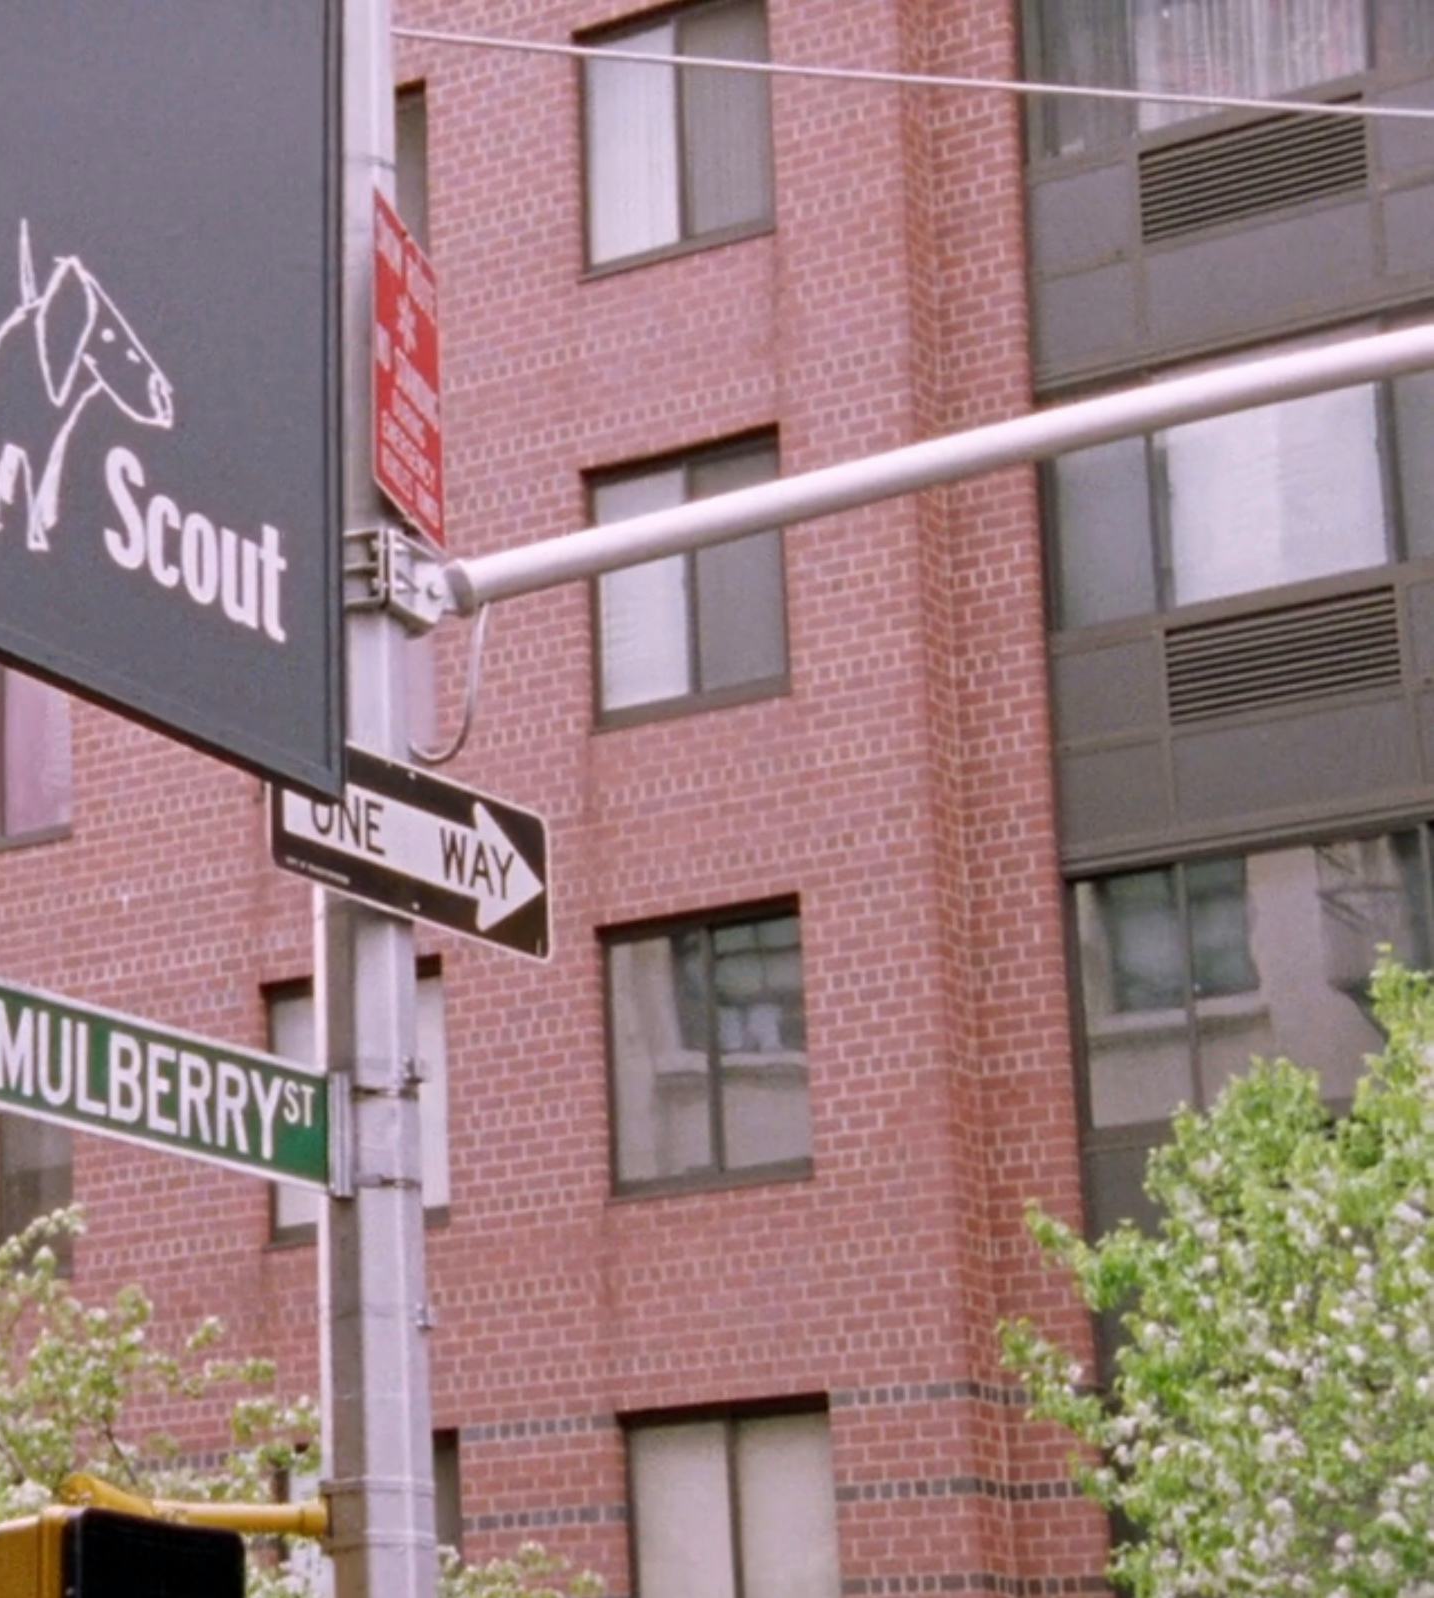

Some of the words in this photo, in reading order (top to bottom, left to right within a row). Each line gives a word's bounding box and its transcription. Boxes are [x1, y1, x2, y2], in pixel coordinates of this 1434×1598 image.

[104, 446, 287, 643] Scout
[310, 796, 386, 857] ONE
[439, 826, 514, 900] WAY
[283, 1081, 315, 1129] ST
